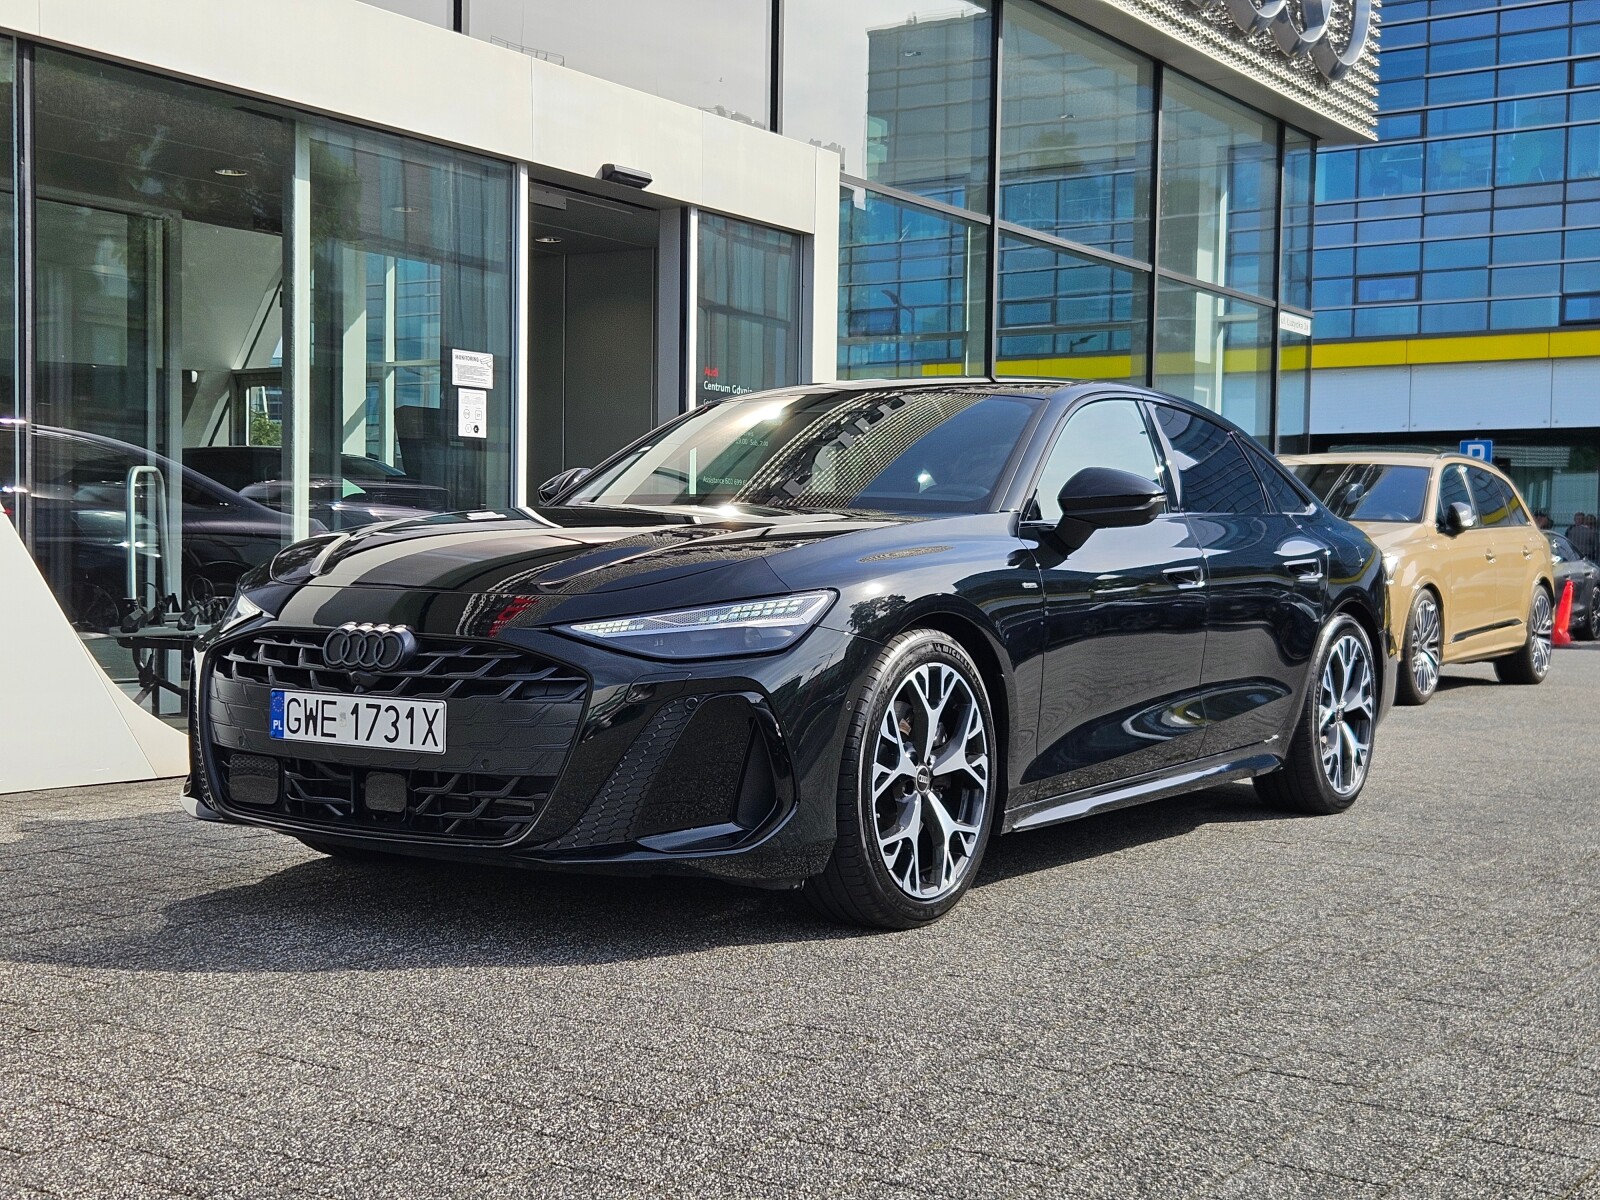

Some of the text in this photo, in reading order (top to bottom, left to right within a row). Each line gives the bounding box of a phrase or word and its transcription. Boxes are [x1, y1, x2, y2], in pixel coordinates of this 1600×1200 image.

[455, 354, 479, 363] MONITORING
[704, 367, 718, 378] Audi
[703, 380, 731, 393] Centrum
[1467, 444, 1485, 460] P
[273, 720, 283, 731] PL
[286, 697, 440, 747] GWE 1731X
